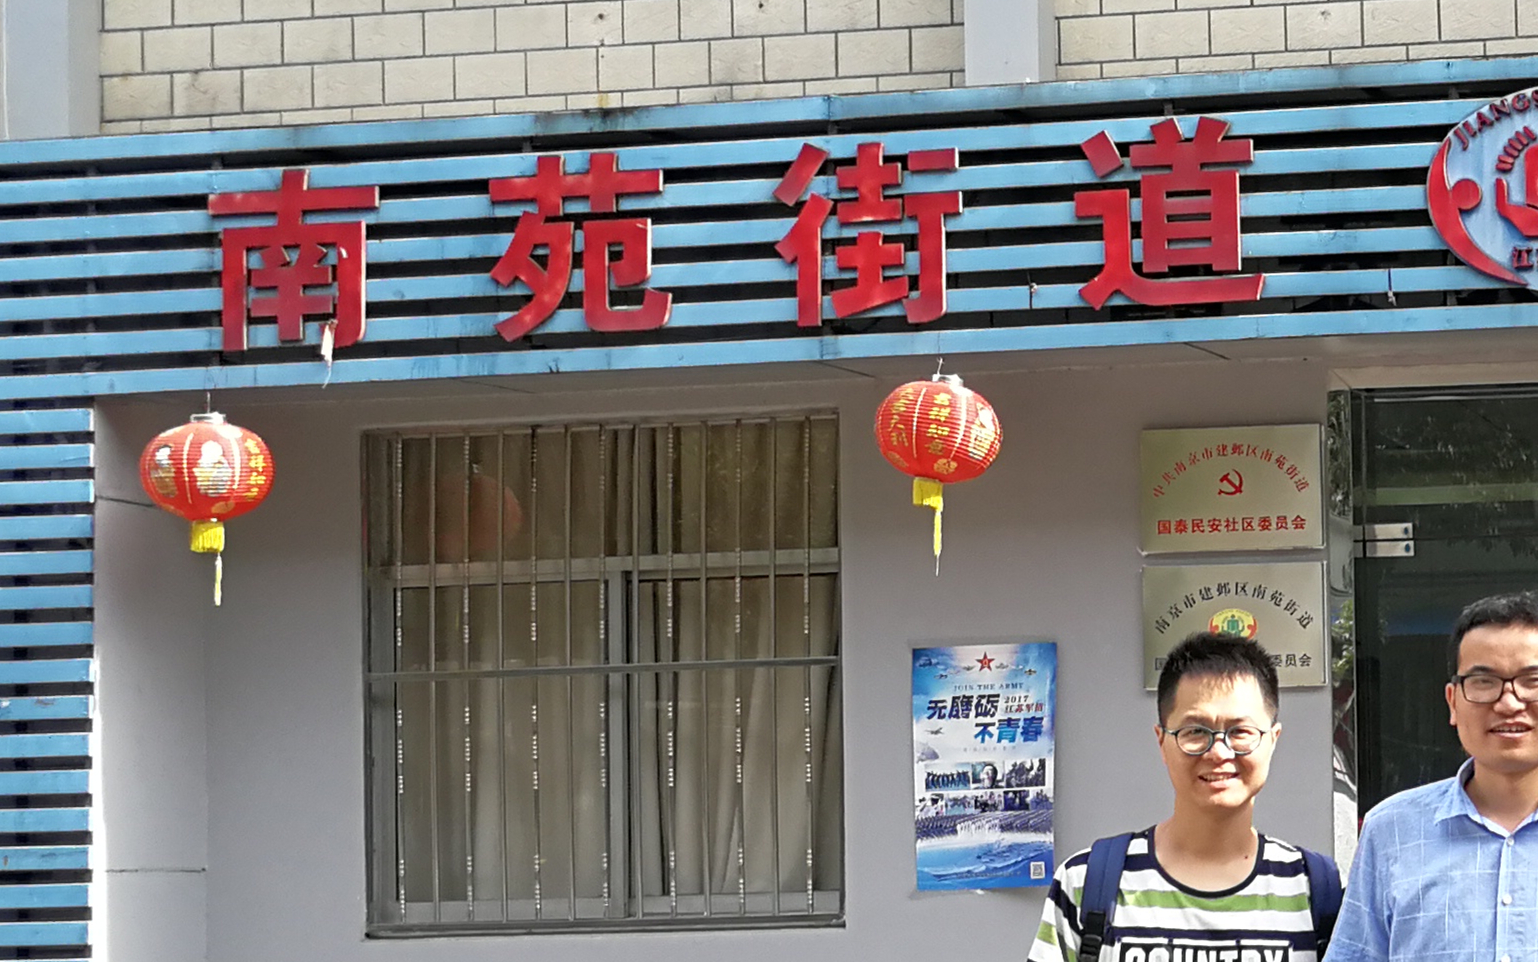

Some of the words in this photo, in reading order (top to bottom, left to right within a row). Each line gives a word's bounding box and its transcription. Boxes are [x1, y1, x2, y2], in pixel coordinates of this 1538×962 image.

[207, 115, 1267, 355] 南苑街道
[1157, 514, 1307, 535] 国泰民安社区委员会
[1155, 581, 1314, 635] 南京市建邺区南苑街道
[953, 684, 974, 692] JOIN
[977, 683, 996, 691] THE
[999, 682, 1024, 690] ARMY
[1004, 695, 1030, 704] 2017
[974, 716, 1044, 744] 不青春
